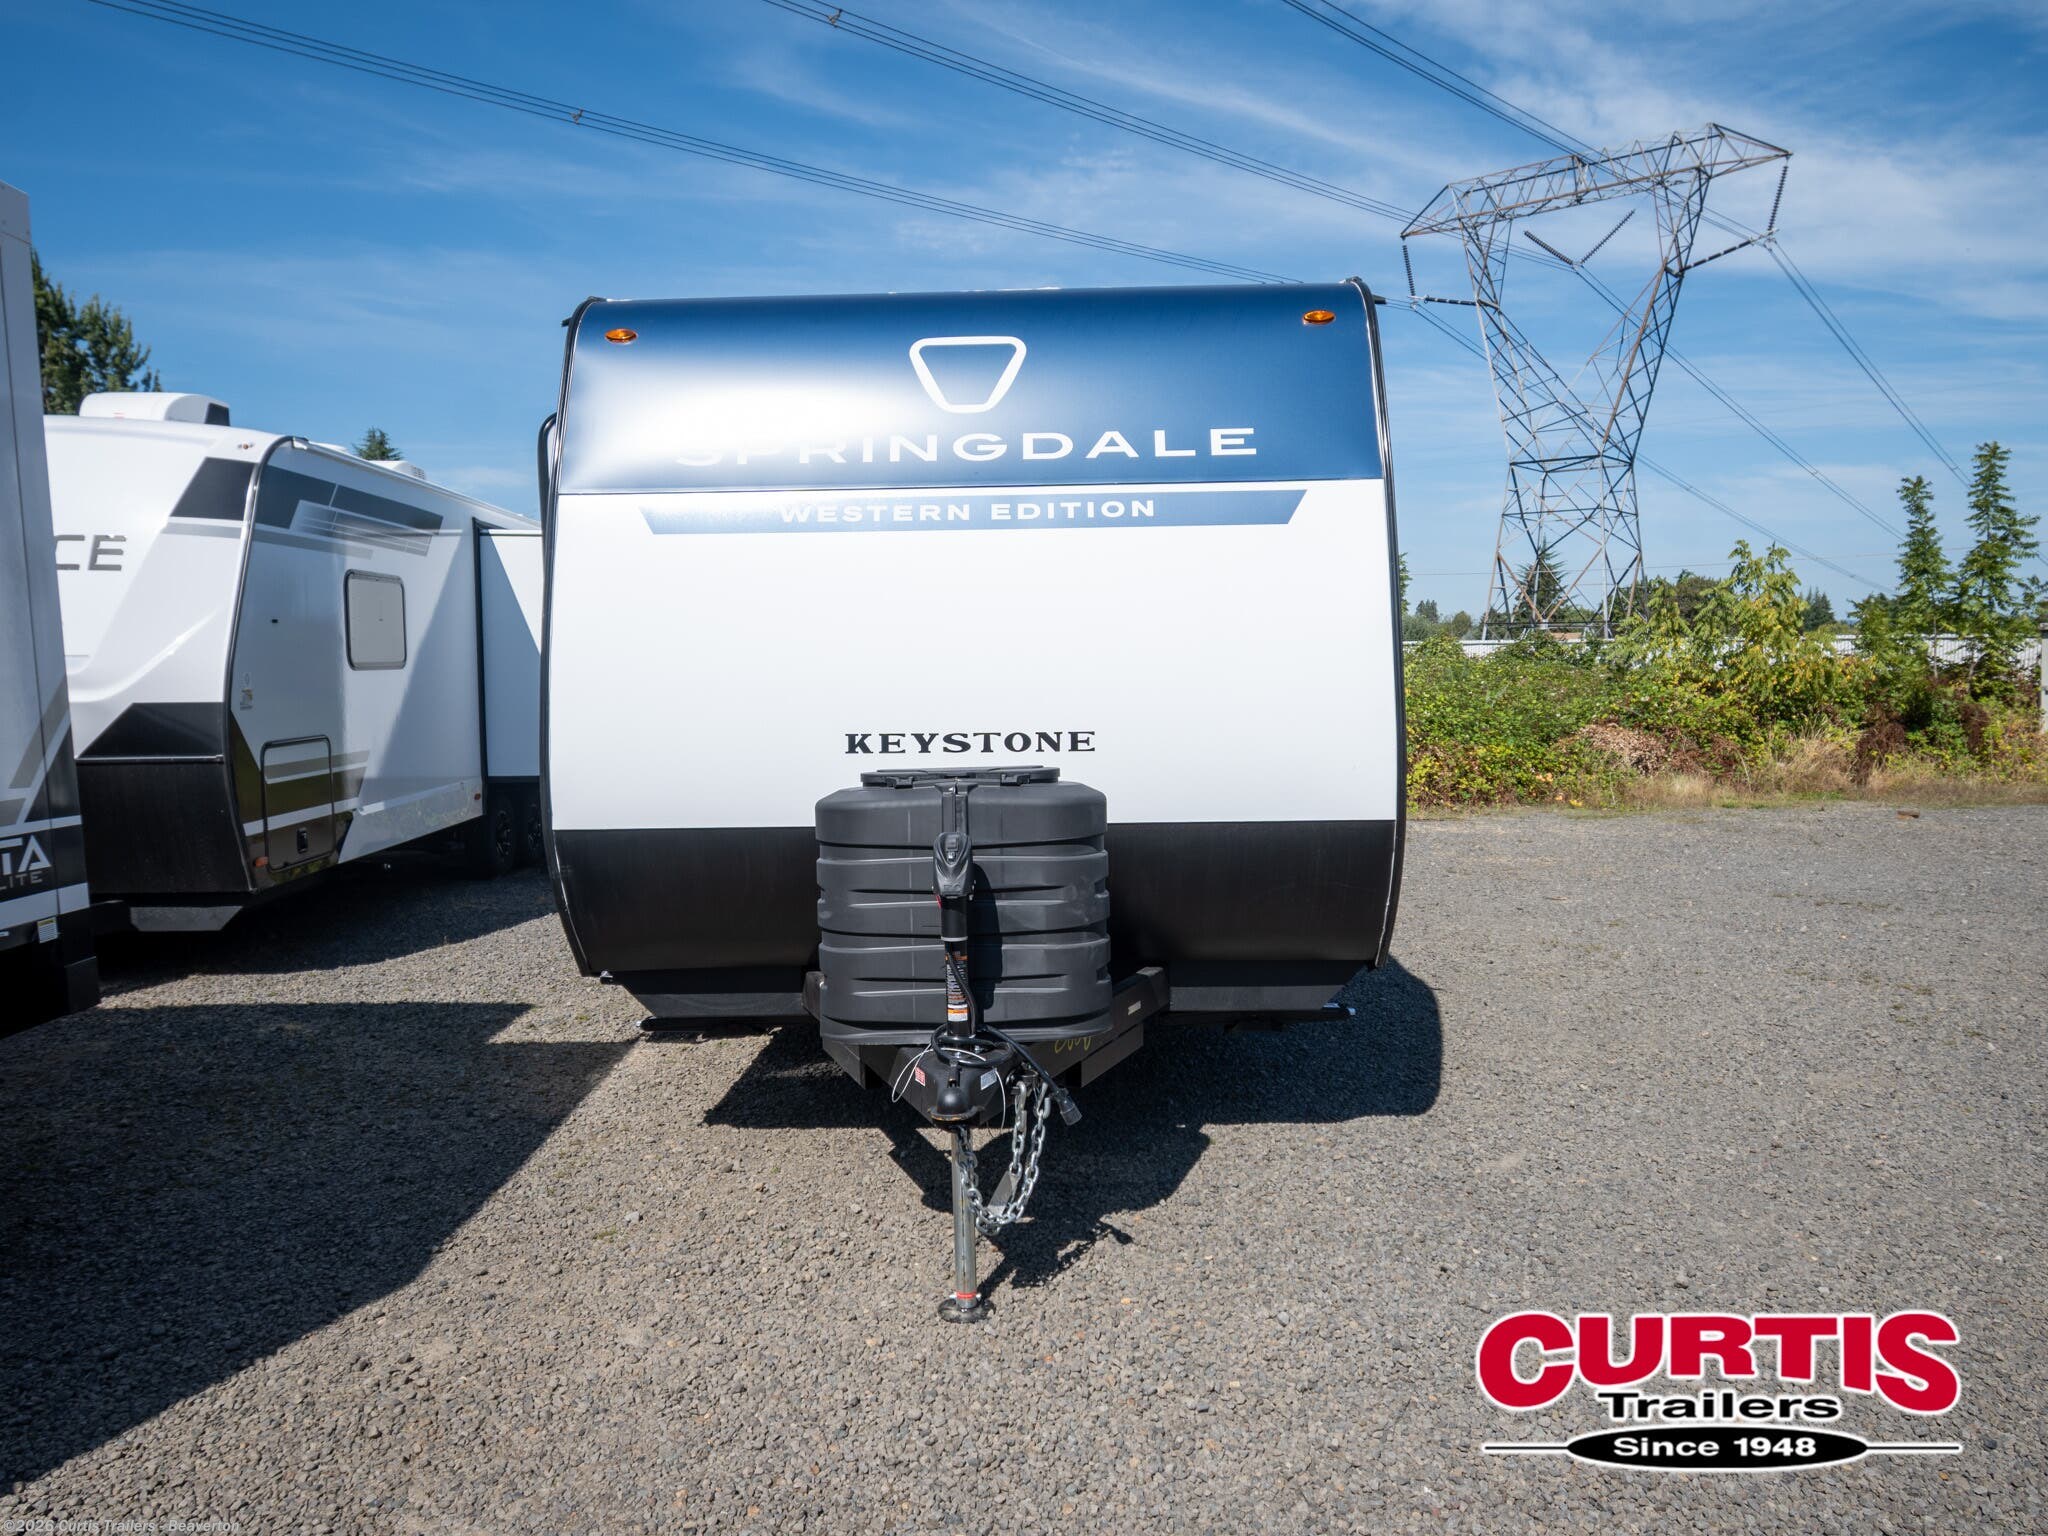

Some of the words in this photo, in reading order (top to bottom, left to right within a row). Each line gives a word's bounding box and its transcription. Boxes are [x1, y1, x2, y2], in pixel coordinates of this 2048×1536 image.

[779, 504, 971, 524] WESTERN
[991, 500, 1154, 520] EDITION
[845, 731, 1096, 754] KEYSTONE
